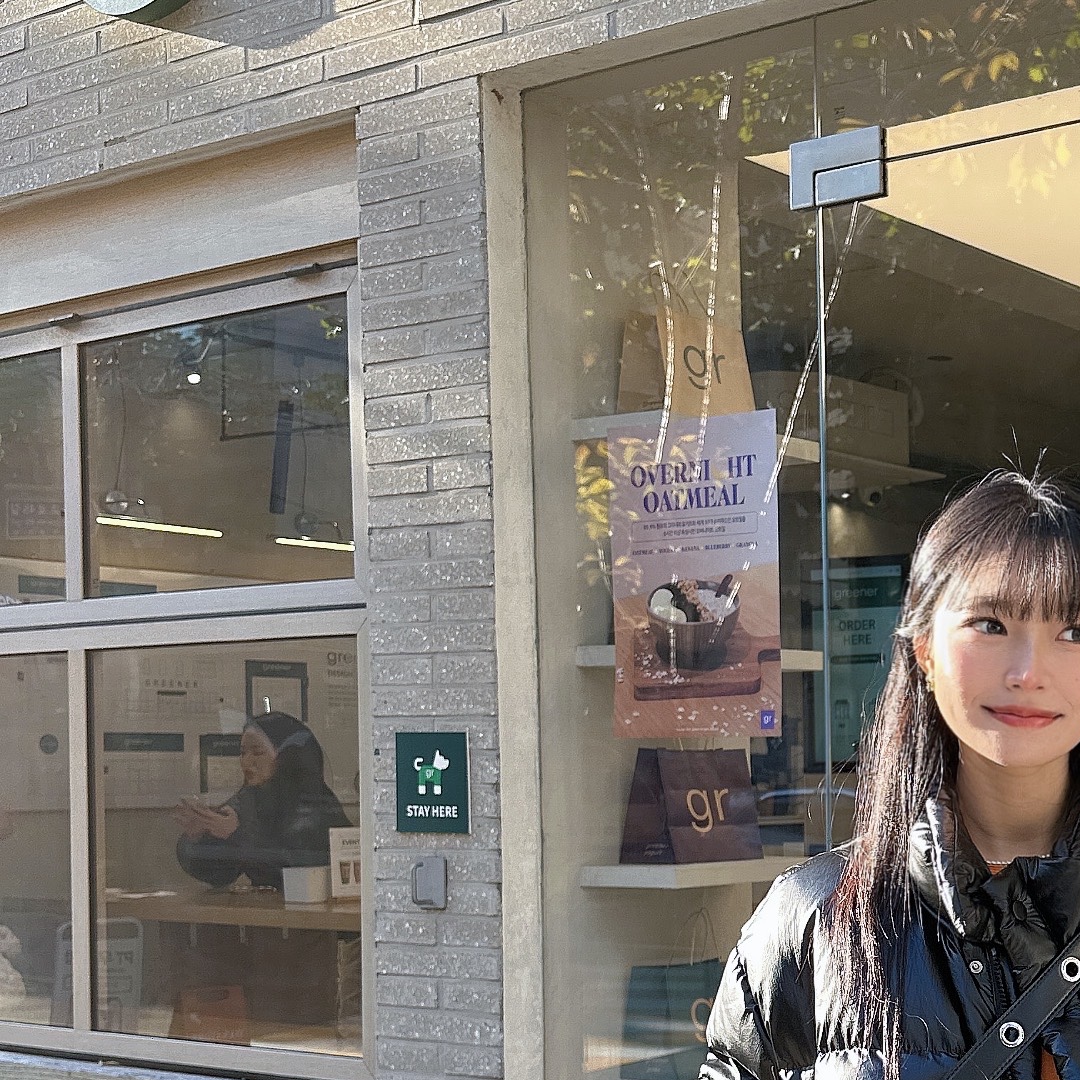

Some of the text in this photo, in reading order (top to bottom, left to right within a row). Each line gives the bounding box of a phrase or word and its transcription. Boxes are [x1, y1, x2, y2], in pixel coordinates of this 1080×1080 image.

[683, 345, 726, 390] gr
[630, 454, 757, 488] OVERNIHT
[643, 483, 746, 513] OATMEAL
[834, 588, 878, 600] greener
[839, 619, 876, 632] ORDER
[843, 633, 872, 646] HERE
[763, 715, 772, 725] gr
[425, 768, 435, 779] gr
[406, 804, 459, 818] STAY HERE
[686, 788, 728, 833] gr
